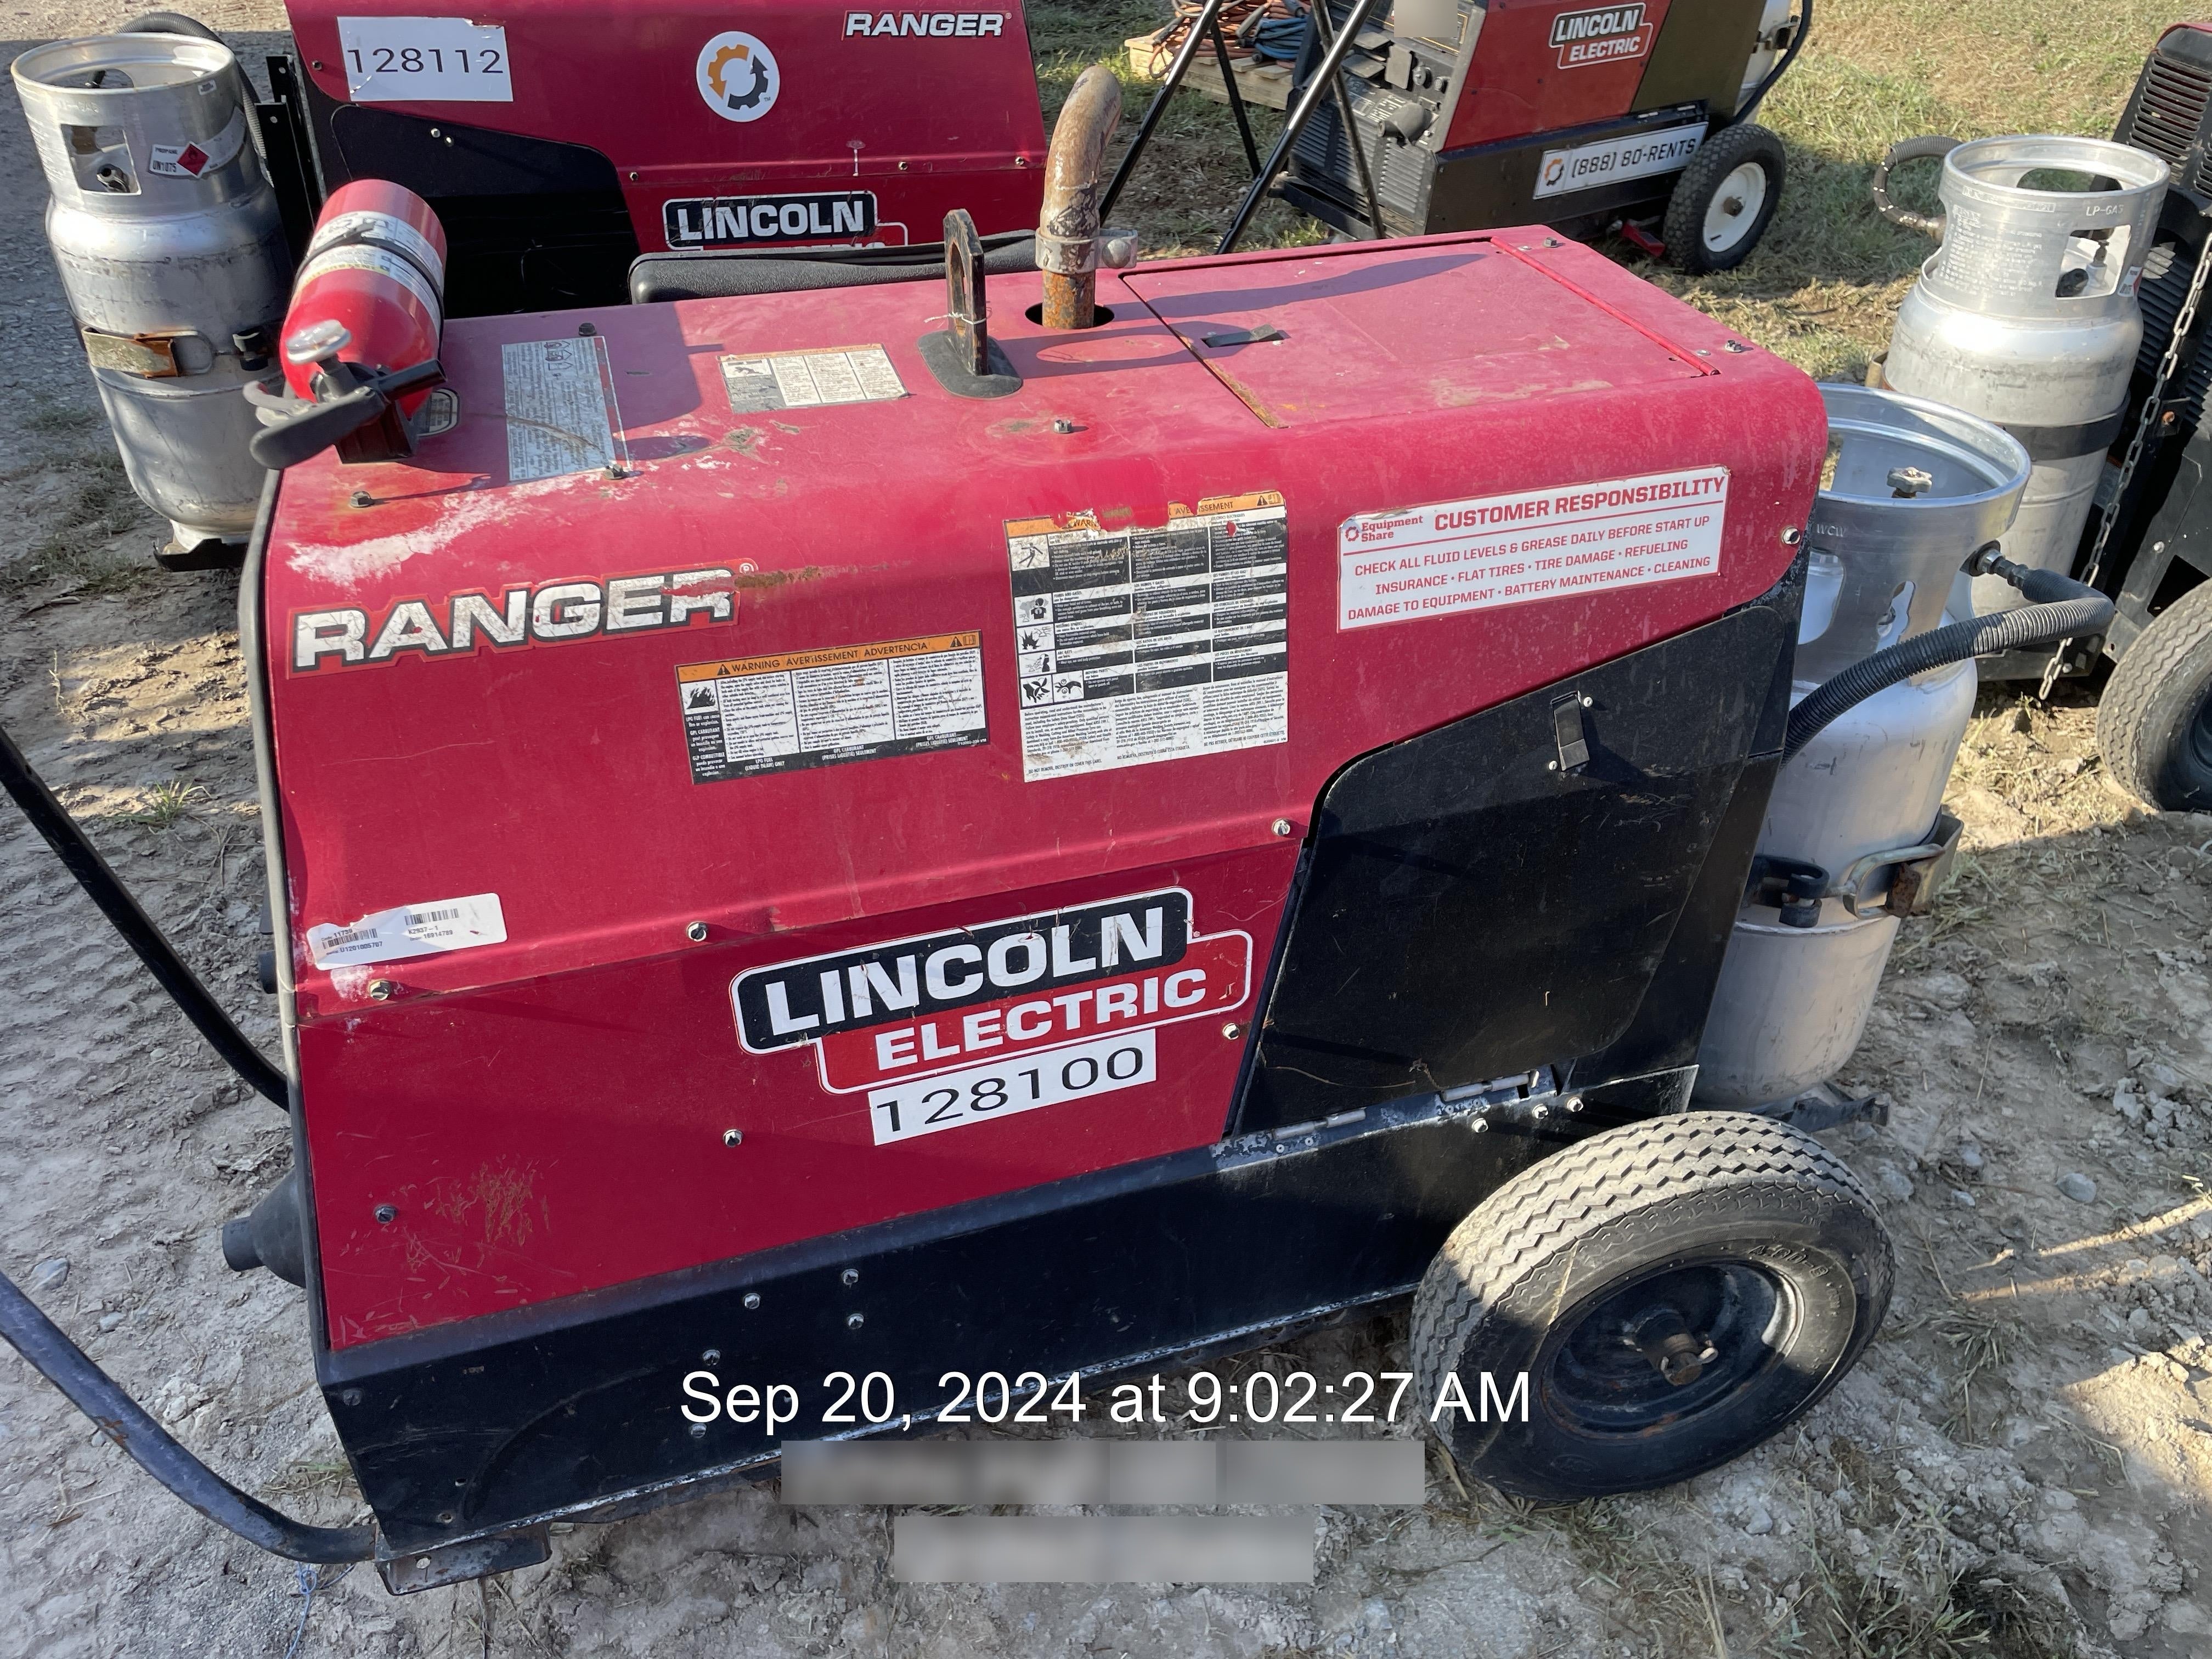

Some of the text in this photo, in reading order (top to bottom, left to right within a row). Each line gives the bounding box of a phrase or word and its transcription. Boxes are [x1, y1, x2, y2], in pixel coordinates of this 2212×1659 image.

[846, 13, 1003, 36] RANGER
[1555, 9, 1639, 42] LINCOLN
[347, 48, 503, 74] 128112
[1569, 36, 1641, 62] ELECTRIC
[1571, 138, 1696, 178] (888) 80-RENTS
[677, 200, 864, 241] LINCOLN
[2085, 205, 2124, 216] LP-GAS
[1362, 516, 1423, 532] Equipment
[1434, 477, 1725, 532] CUSTOMER RESPONSIBILITY
[1355, 516, 1709, 576] CHECK ALL FLUID LEVELS & GREASE DAILY BEFORE START UP
[1362, 531, 1394, 542] Share
[1375, 540, 1688, 595] INSURANCE FLAT TIRES TIRE DAMAGE REFUELING
[1348, 557, 1710, 620] DAMAGE TO EQUIPMENT BATTERY MAINTENANCE CLEANING
[295, 569, 736, 668] RANGER
[732, 642, 928, 673] WARNING AVERTISSEMENT ADVERTENCIA
[765, 907, 1164, 1036] LINCOLN
[875, 968, 1207, 1071] ELECTRIC
[877, 1046, 1143, 1133] 128100
